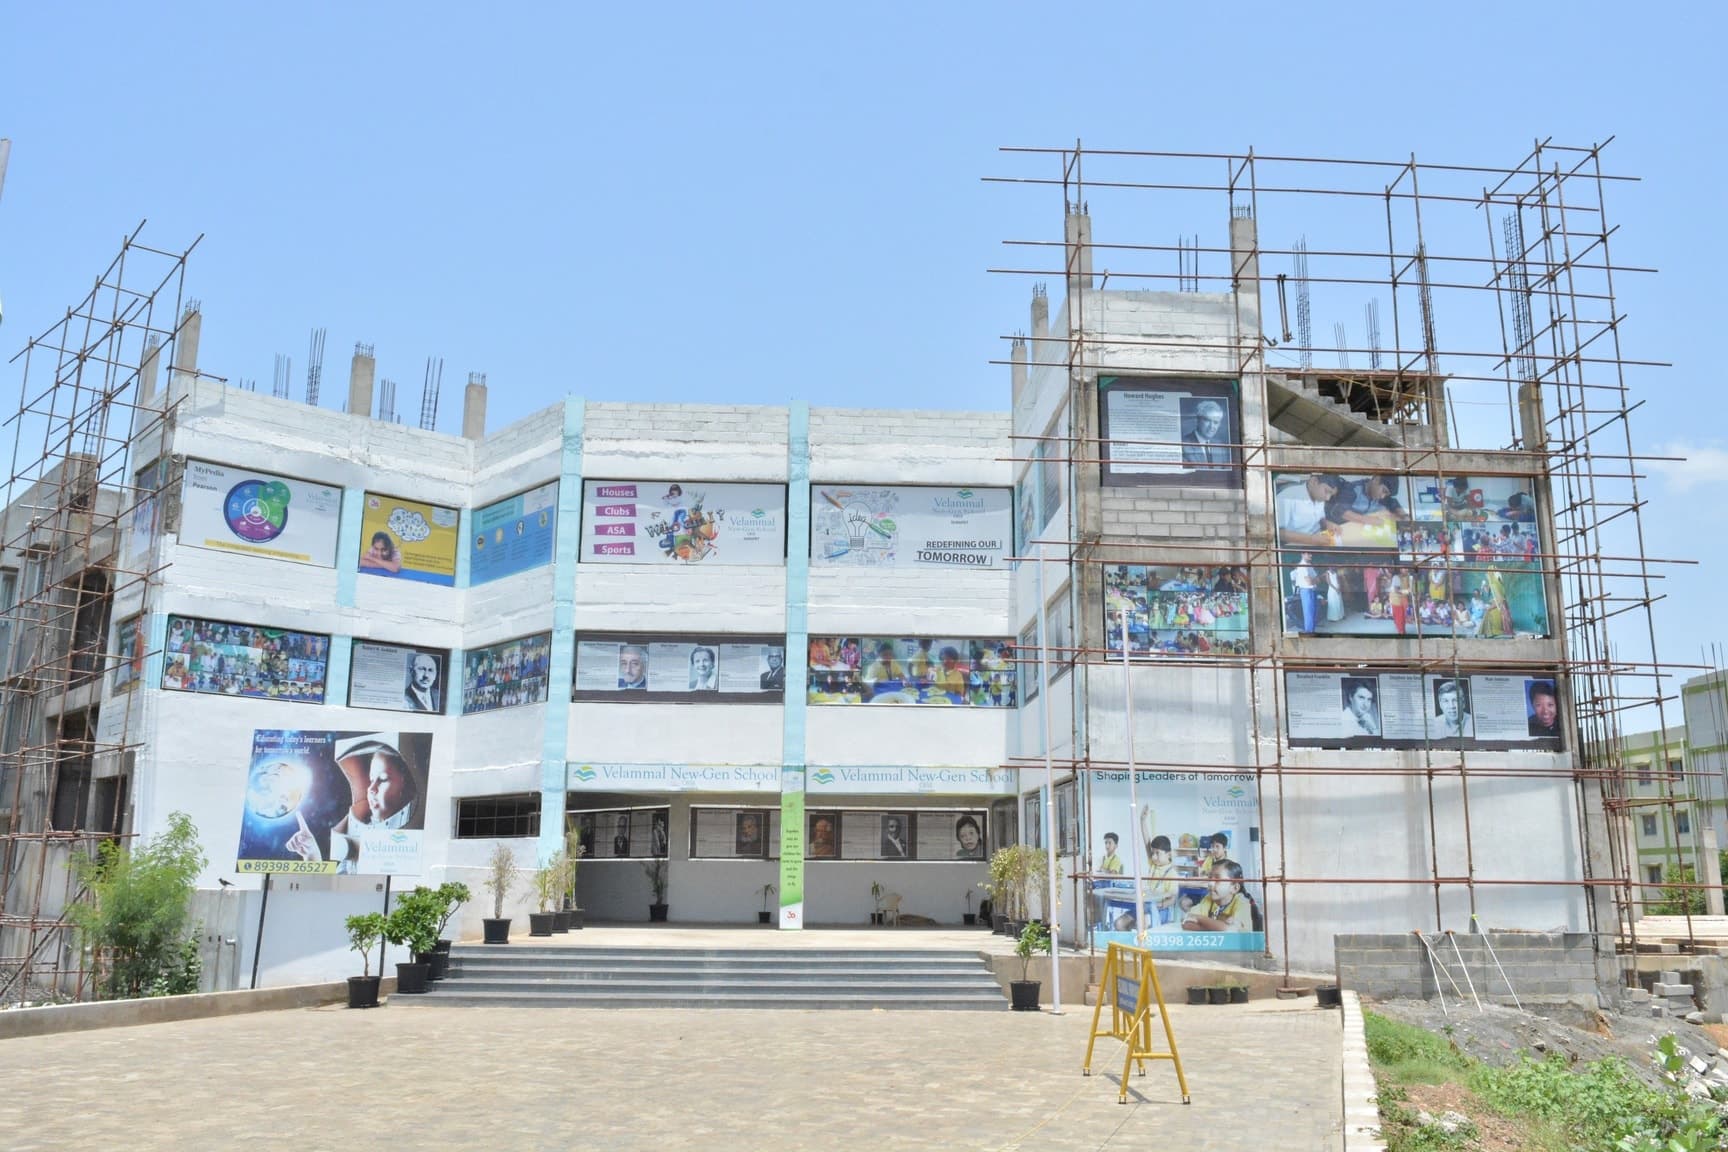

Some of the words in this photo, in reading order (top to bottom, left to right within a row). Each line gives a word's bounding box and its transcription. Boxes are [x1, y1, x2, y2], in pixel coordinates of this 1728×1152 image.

[601, 488, 635, 497] Houses
[934, 496, 984, 508] Velammal
[604, 507, 630, 516] Clubs
[730, 516, 775, 526] Velammal
[606, 526, 626, 535] ASA
[601, 545, 632, 555] Sports
[926, 541, 977, 549] REDEFINING
[917, 551, 987, 564] TOMORROW
[602, 765, 666, 780] Velammal
[671, 766, 730, 780] New-Gen
[734, 767, 778, 781] School
[840, 767, 903, 782] Velammal
[908, 769, 966, 782] New-Gen
[970, 768, 1013, 783] School
[1142, 772, 1185, 781] Leaders
[1188, 772, 1198, 781] of
[1202, 772, 1255, 782] Tomorrow
[1203, 796, 1257, 807] Velammal
[254, 861, 290, 872] 89398
[293, 862, 328, 872] 26527
[1147, 936, 1184, 946] 89398
[1186, 936, 1225, 946] 26527
